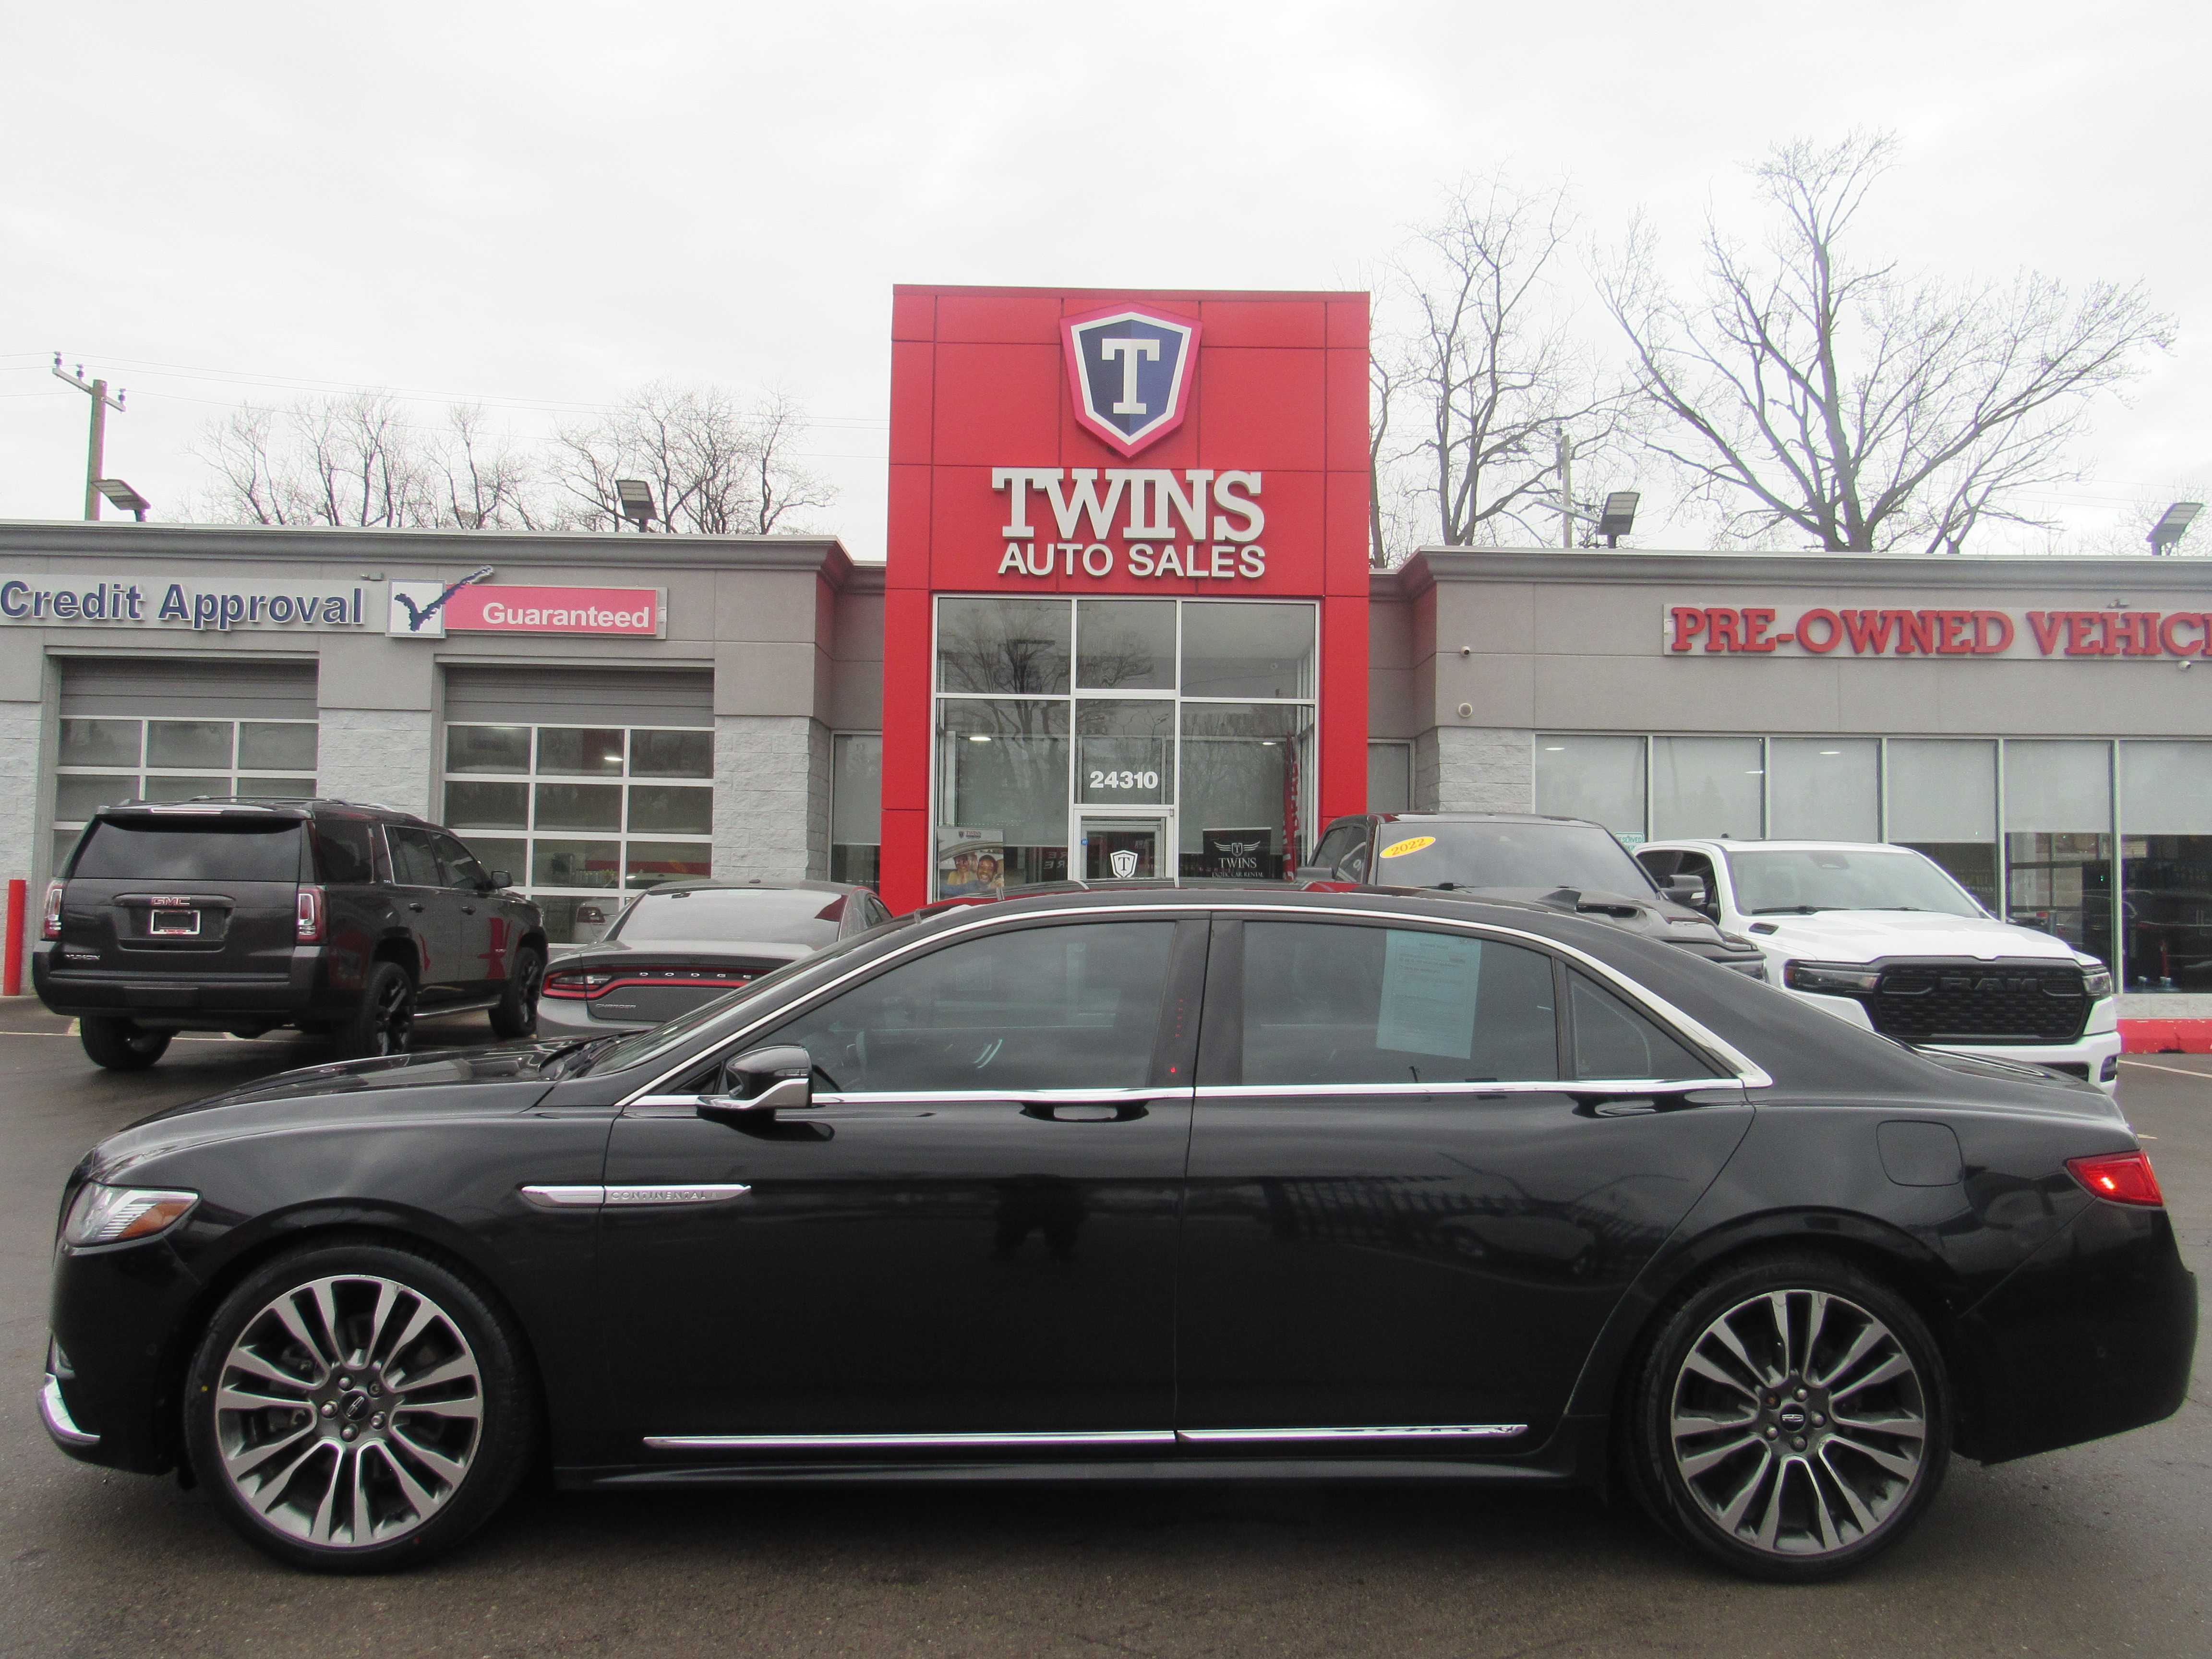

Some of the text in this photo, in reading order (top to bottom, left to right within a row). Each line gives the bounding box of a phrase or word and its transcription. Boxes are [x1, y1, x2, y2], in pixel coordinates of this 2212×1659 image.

[1102, 338, 1160, 415] T
[992, 467, 1265, 543] TWINS
[998, 543, 1265, 578] AUTO SALES
[0, 580, 365, 631] Credit Approval
[482, 602, 649, 628] Guaranteed
[1671, 606, 2212, 657] PRE-OWNED VEHIC
[1090, 771, 1158, 789] 24310
[1391, 839, 1426, 855] 2022
[1118, 857, 1130, 871] T
[1218, 857, 1257, 868] TWINS
[152, 896, 191, 906] GMC
[639, 972, 752, 980] DODGE
[1941, 977, 2037, 991] RAM
[611, 1191, 706, 1200] CONTINENTAL
